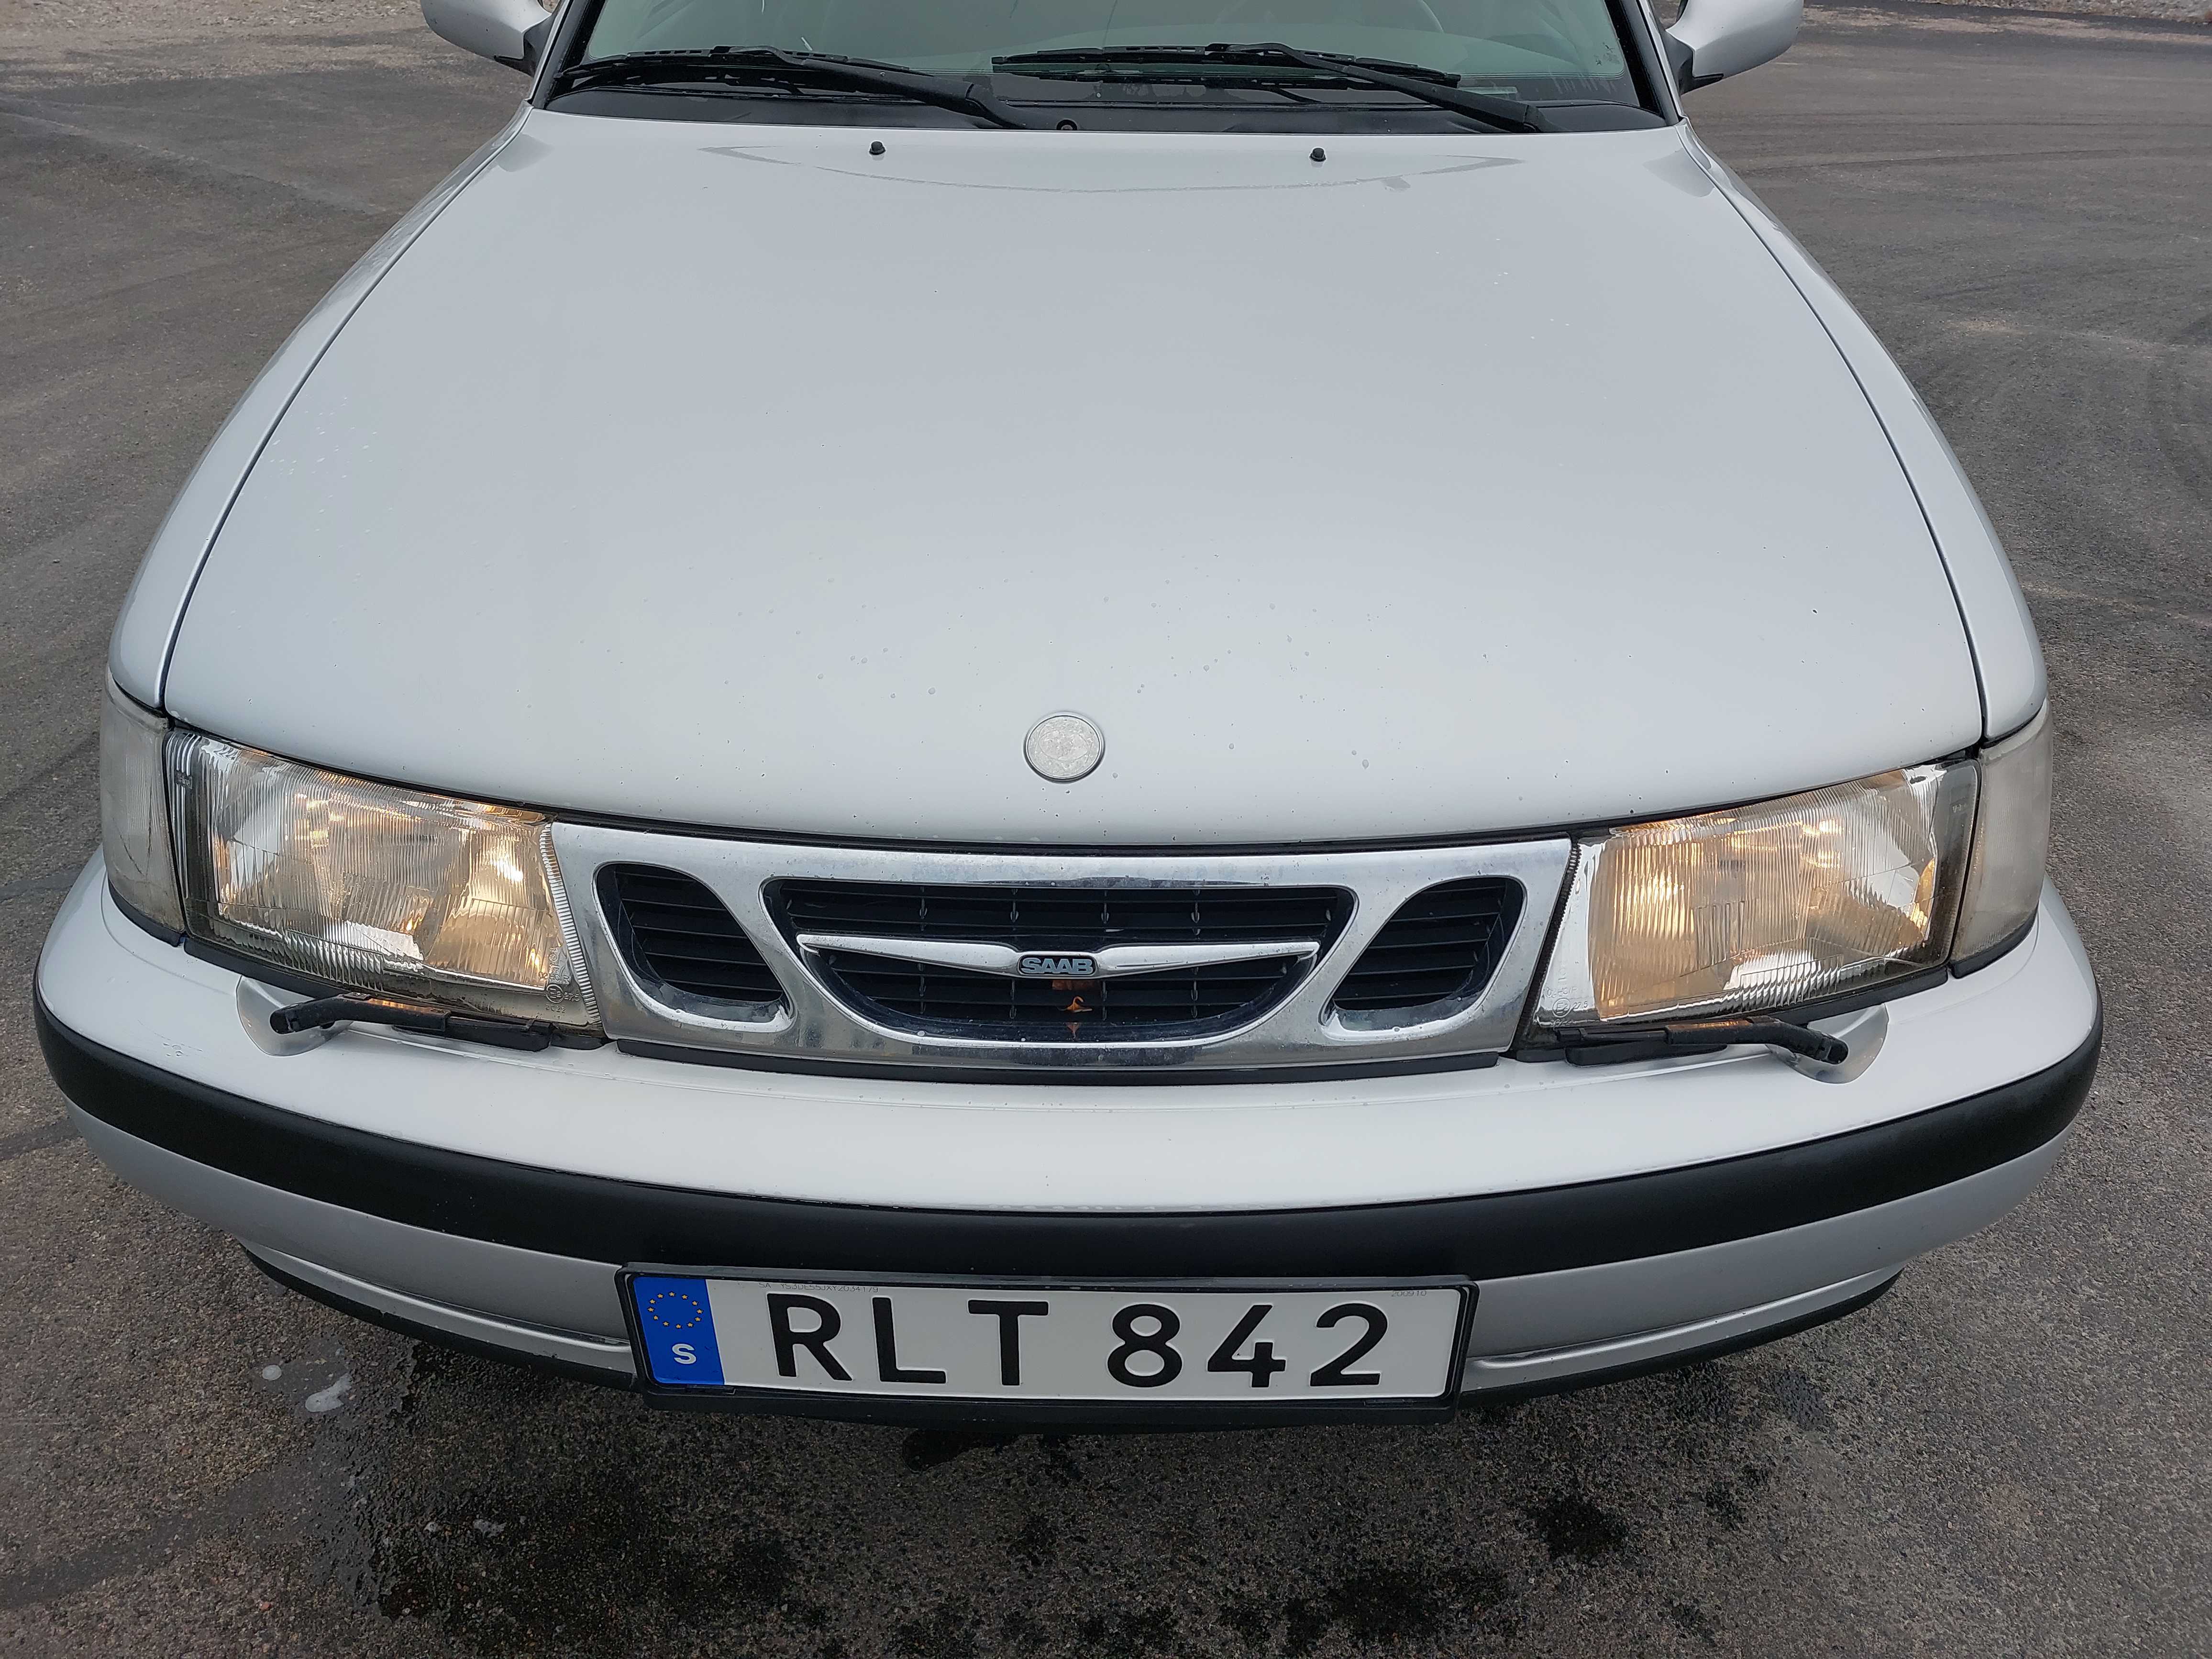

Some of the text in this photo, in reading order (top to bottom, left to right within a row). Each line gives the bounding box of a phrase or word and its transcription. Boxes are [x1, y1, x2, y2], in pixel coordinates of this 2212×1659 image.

[1021, 957, 1094, 974] SAAB
[767, 1294, 1388, 1388] RLT 842
[672, 1343, 697, 1364] S
